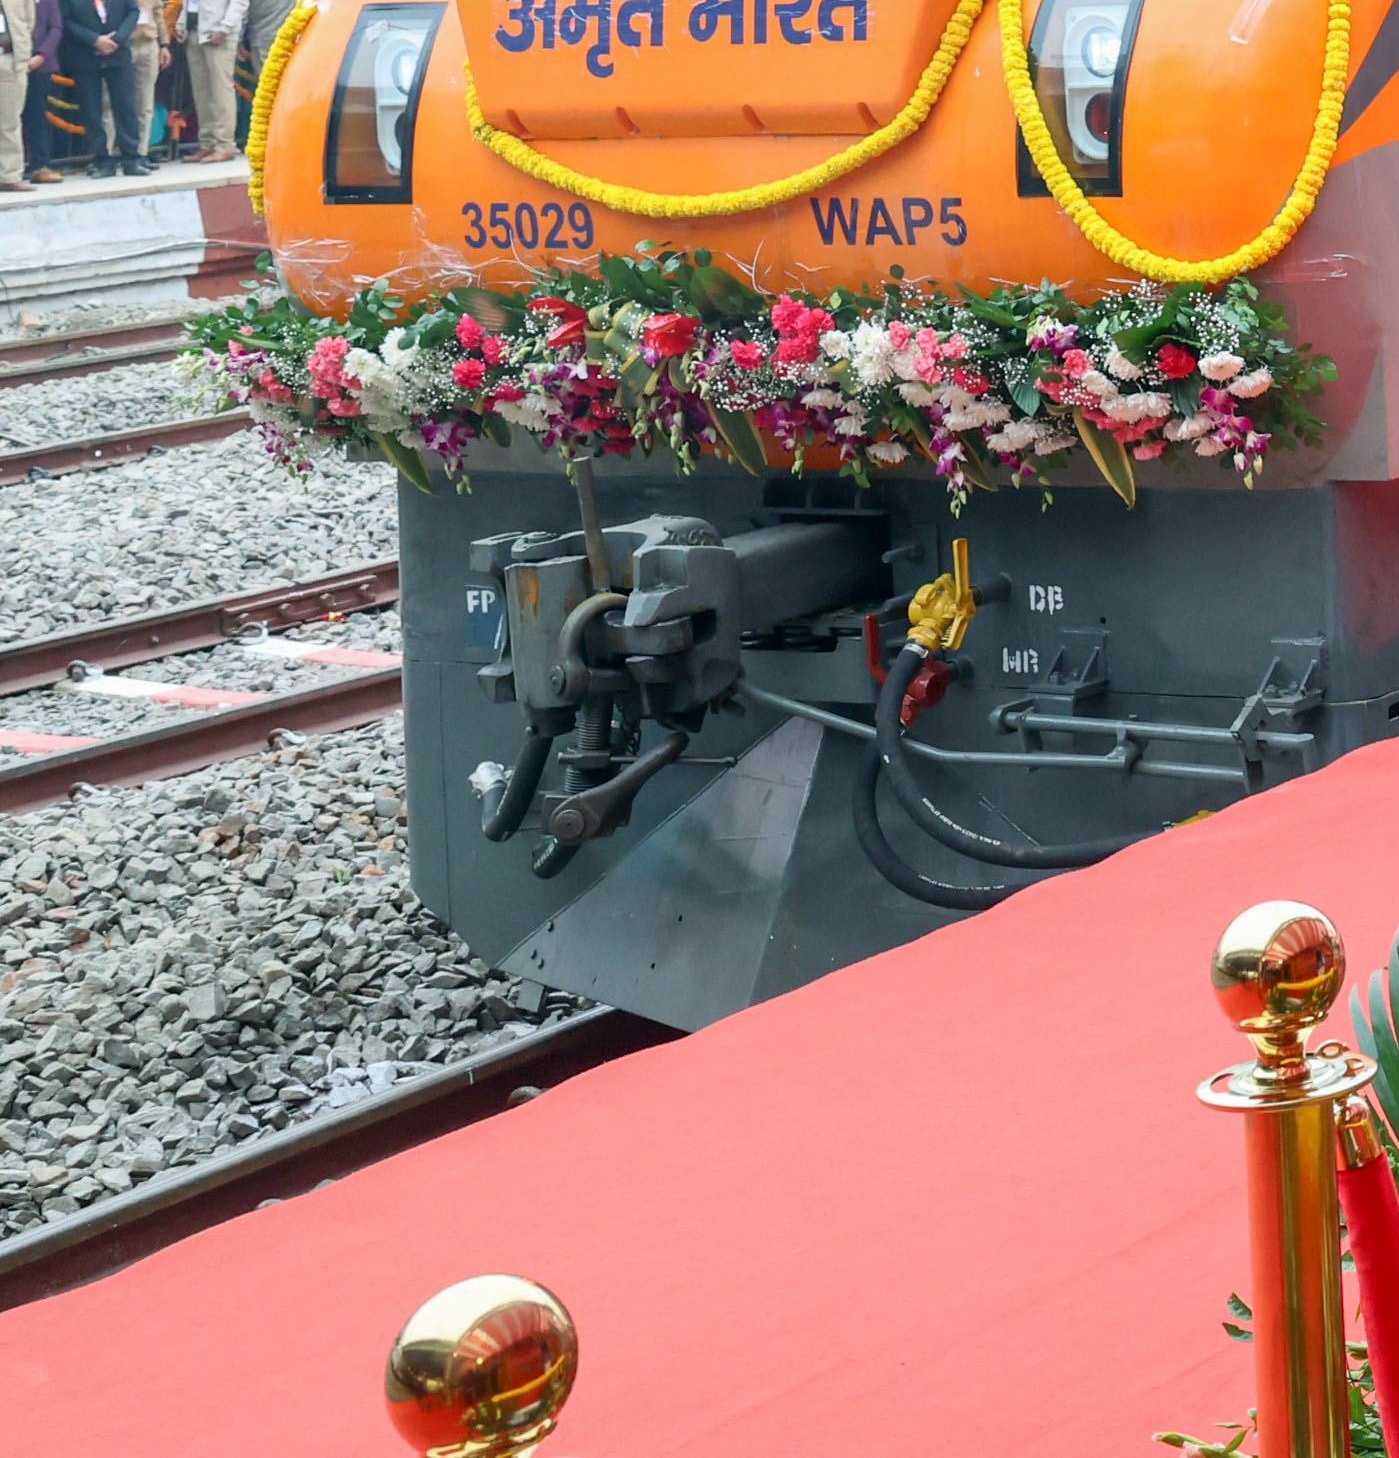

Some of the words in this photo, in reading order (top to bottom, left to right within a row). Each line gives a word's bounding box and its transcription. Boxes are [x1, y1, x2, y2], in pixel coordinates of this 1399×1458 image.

[461, 200, 594, 250] 35029
[810, 196, 969, 246] WAP5
[466, 589, 496, 614] FP
